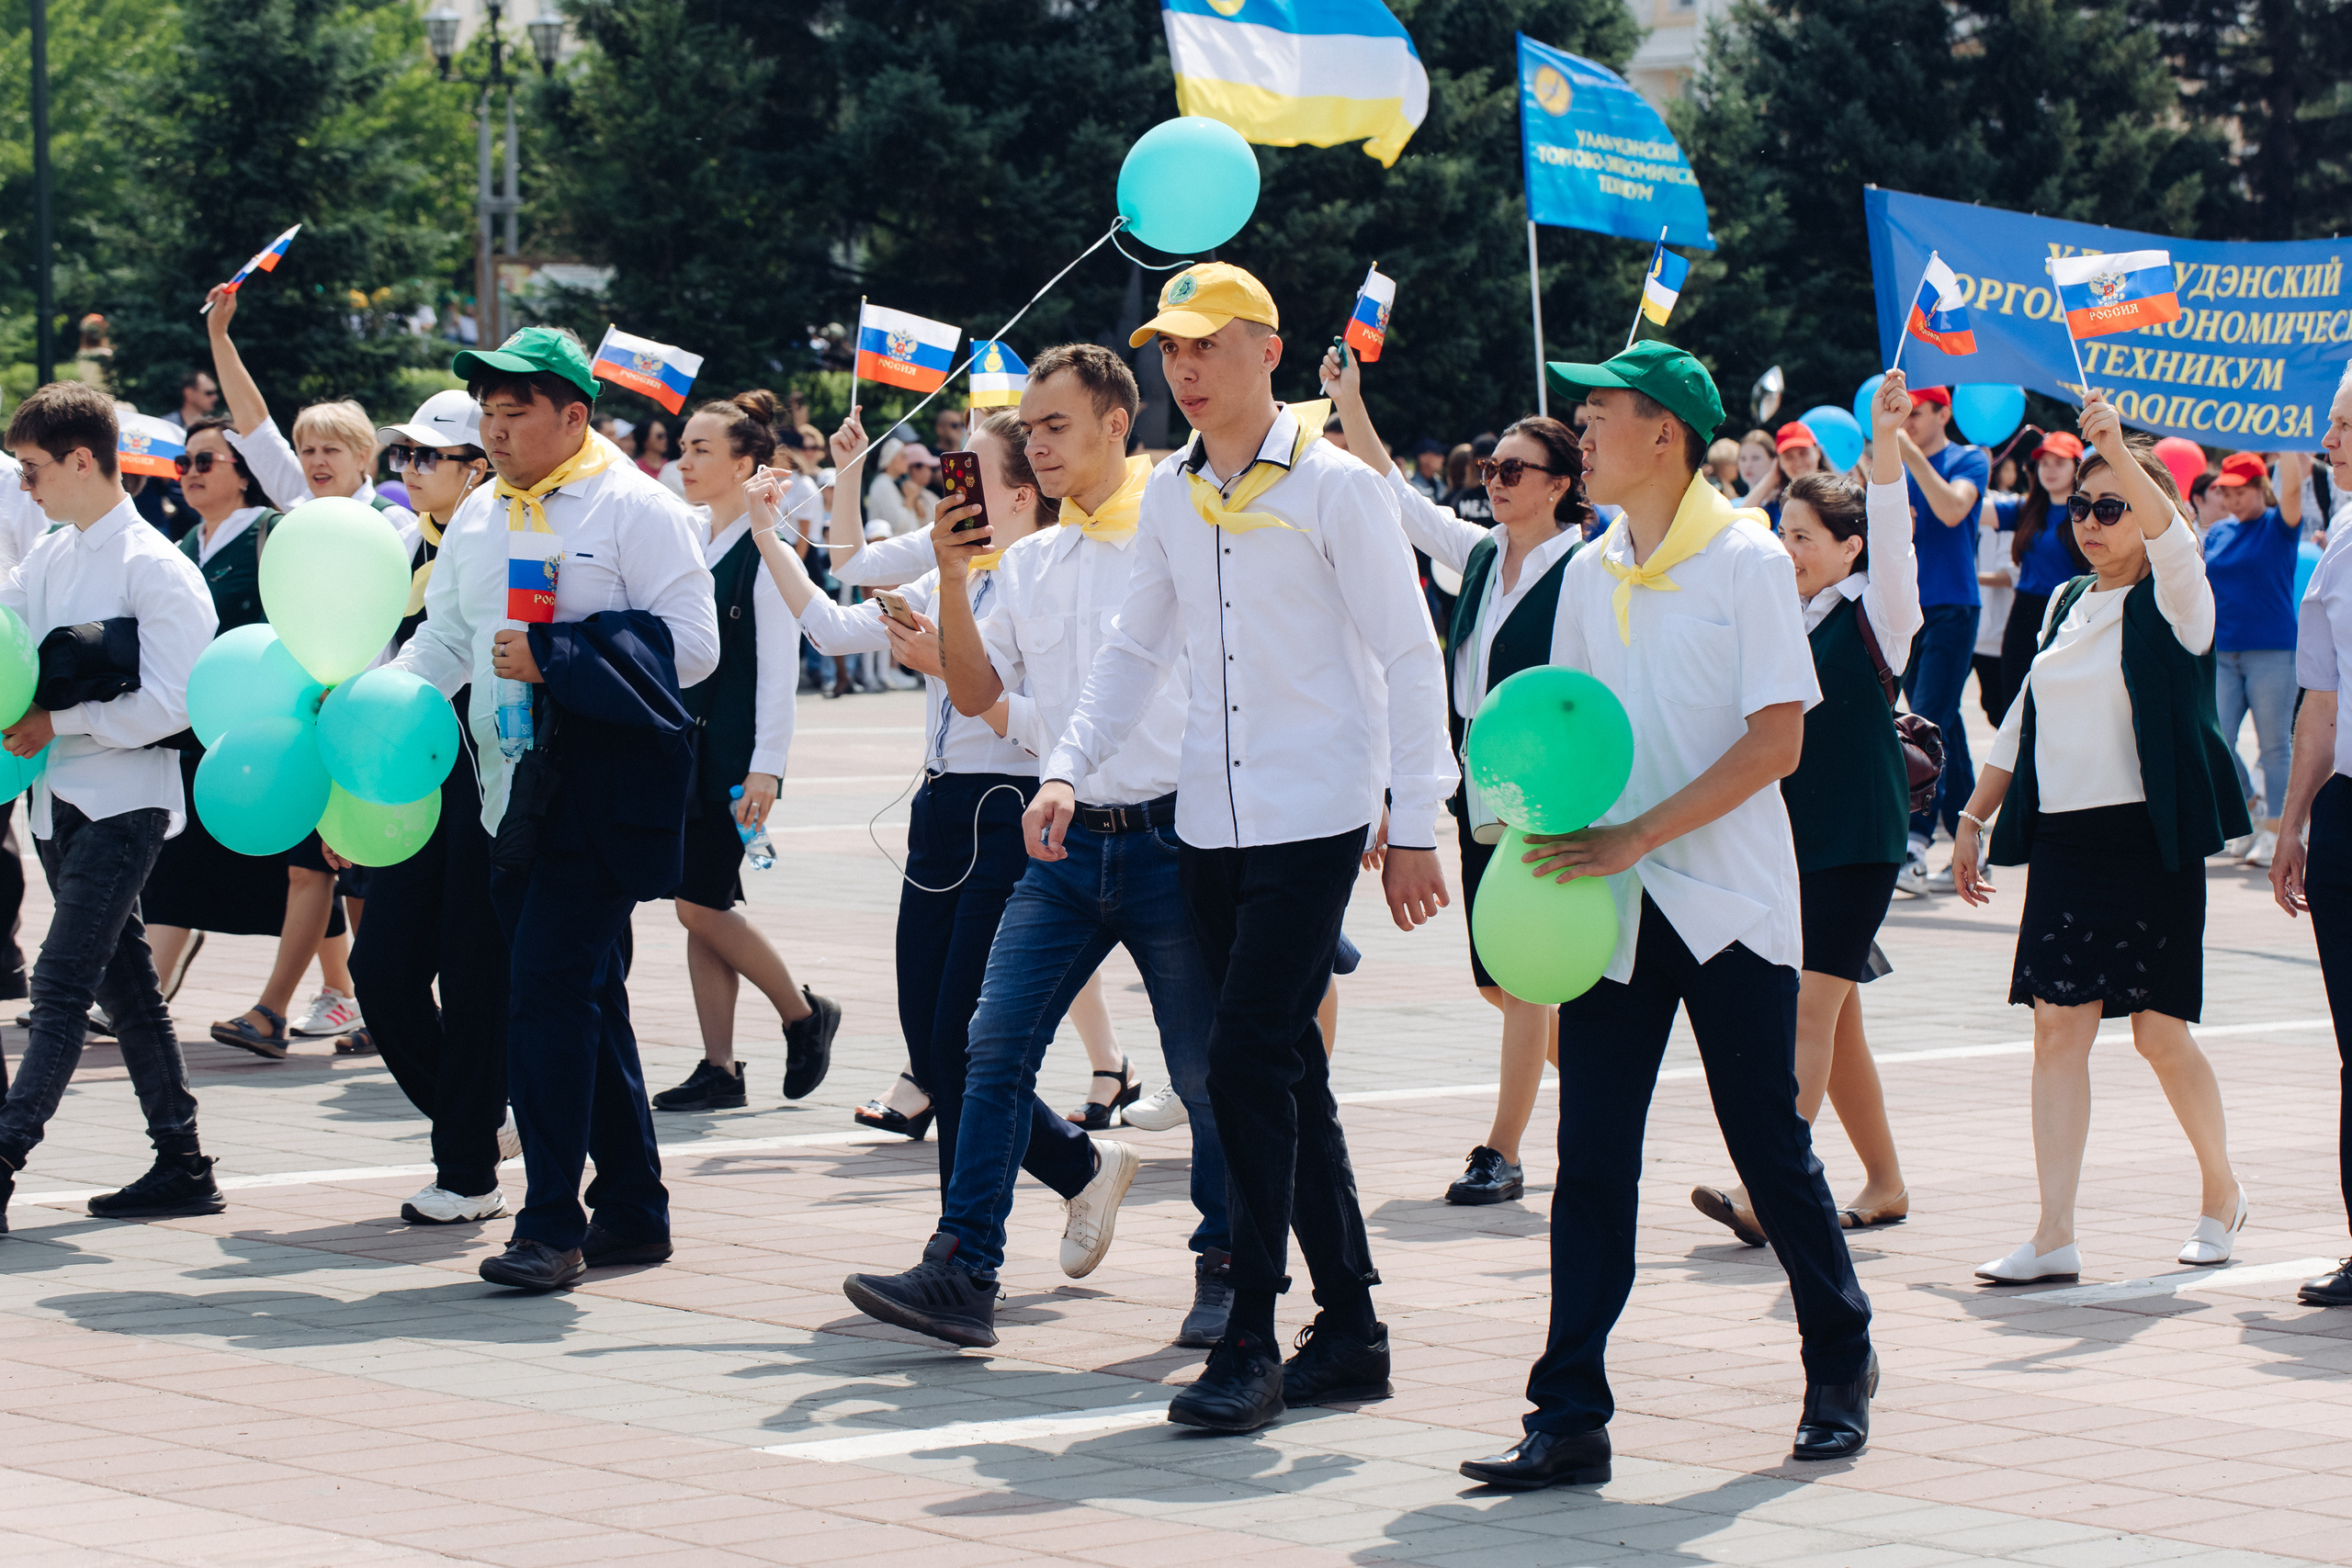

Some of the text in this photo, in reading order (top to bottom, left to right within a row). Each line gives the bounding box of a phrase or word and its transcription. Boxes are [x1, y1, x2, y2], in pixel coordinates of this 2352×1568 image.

[2089, 303, 2140, 321] РОССИЯ
[877, 357, 918, 377] РОССИЯ
[2083, 341, 2287, 391] ТЕХНИКУМ
[619, 369, 662, 389] РОССИЯ
